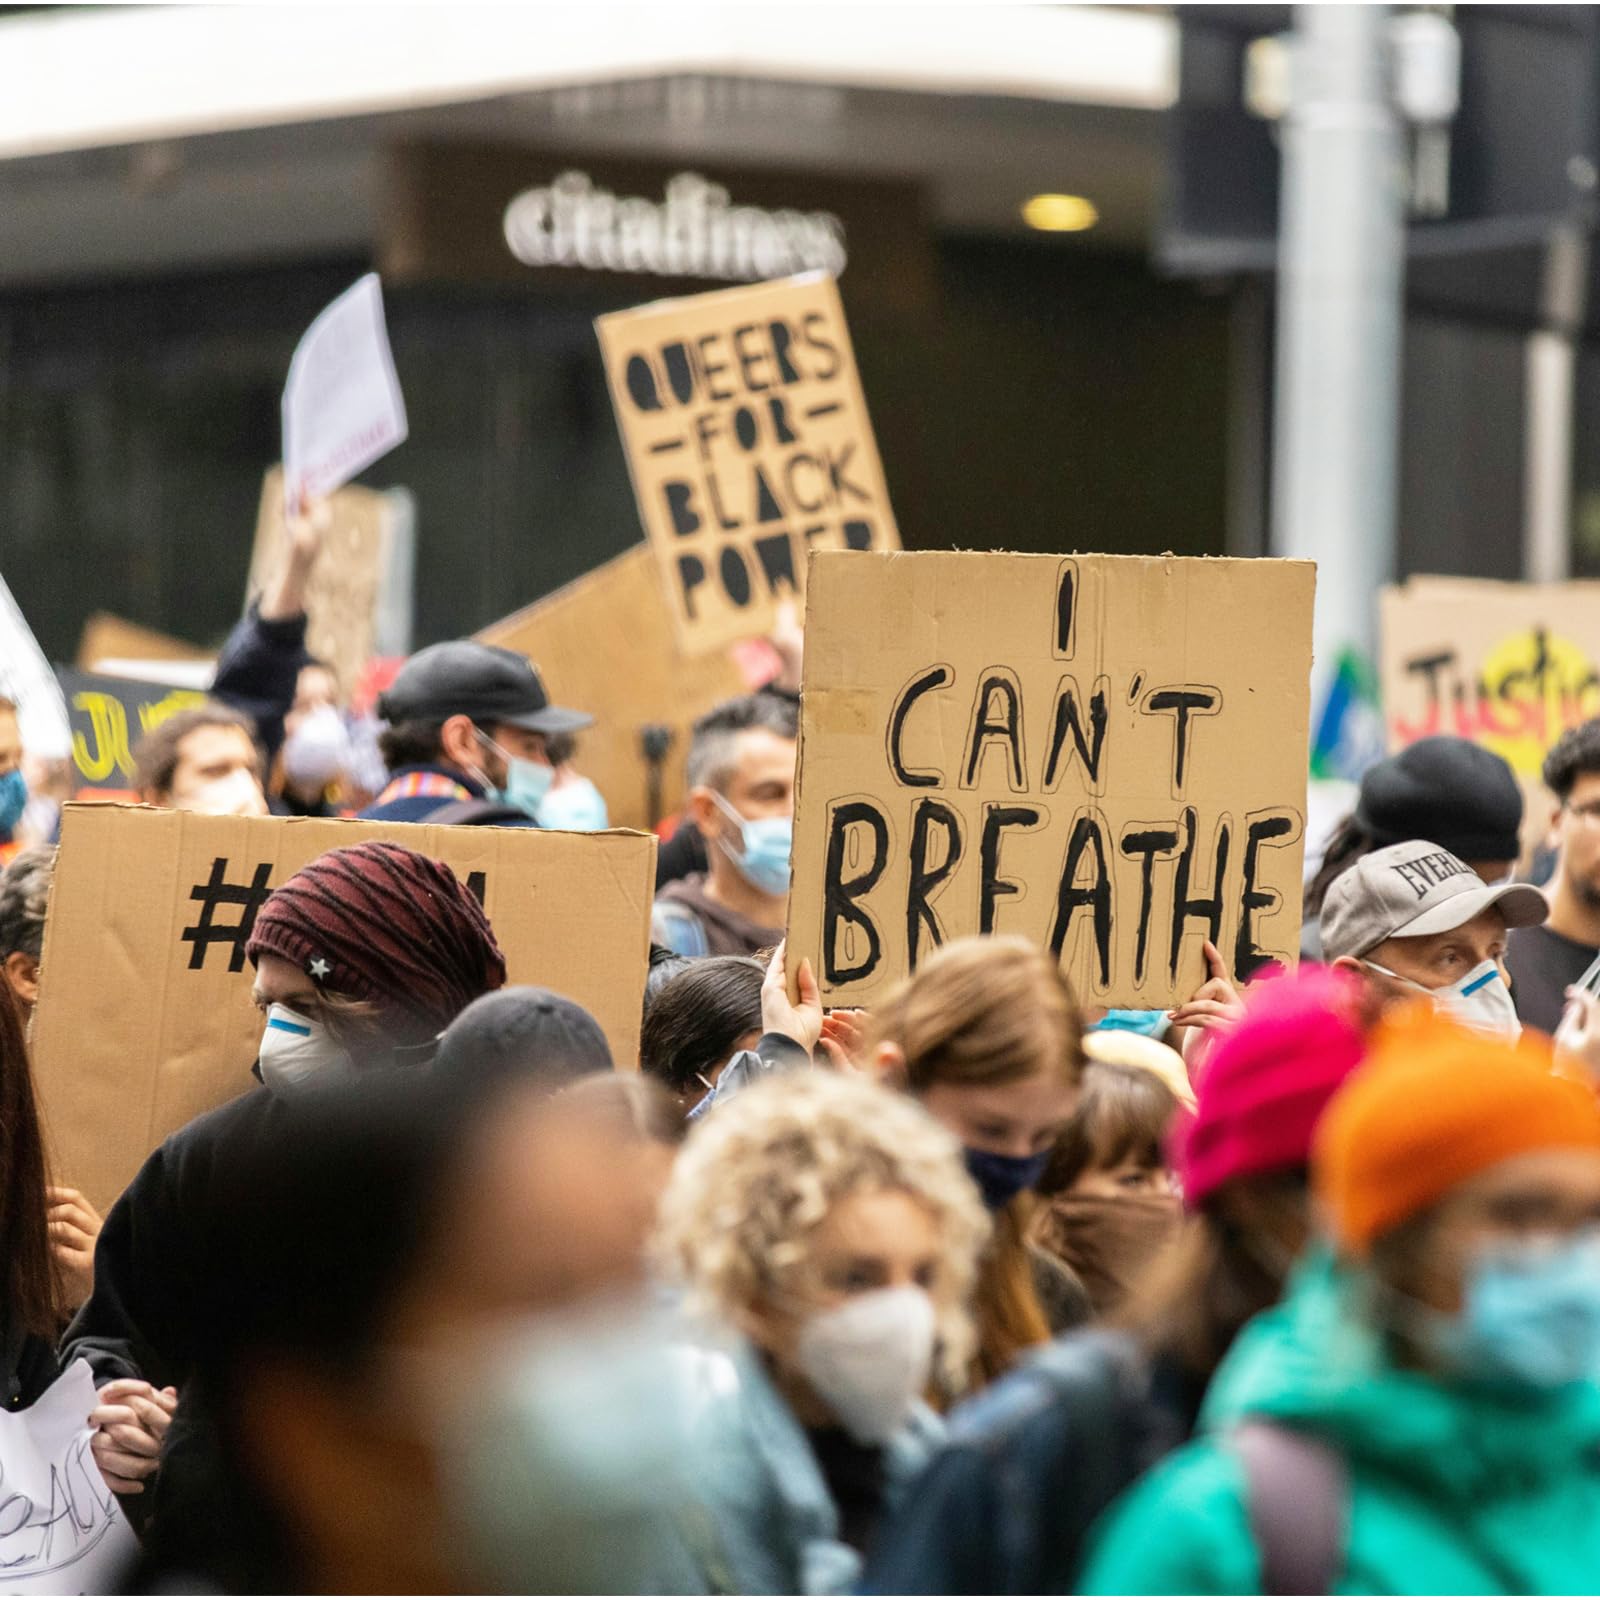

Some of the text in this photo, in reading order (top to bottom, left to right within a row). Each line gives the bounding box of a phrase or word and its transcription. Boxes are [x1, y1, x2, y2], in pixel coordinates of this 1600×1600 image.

[625, 311, 843, 413] QUEERS
[662, 446, 872, 538] BLACK
[1054, 564, 1076, 656] I
[888, 665, 1219, 795] CAN'T
[822, 797, 1299, 990] BREATHE
